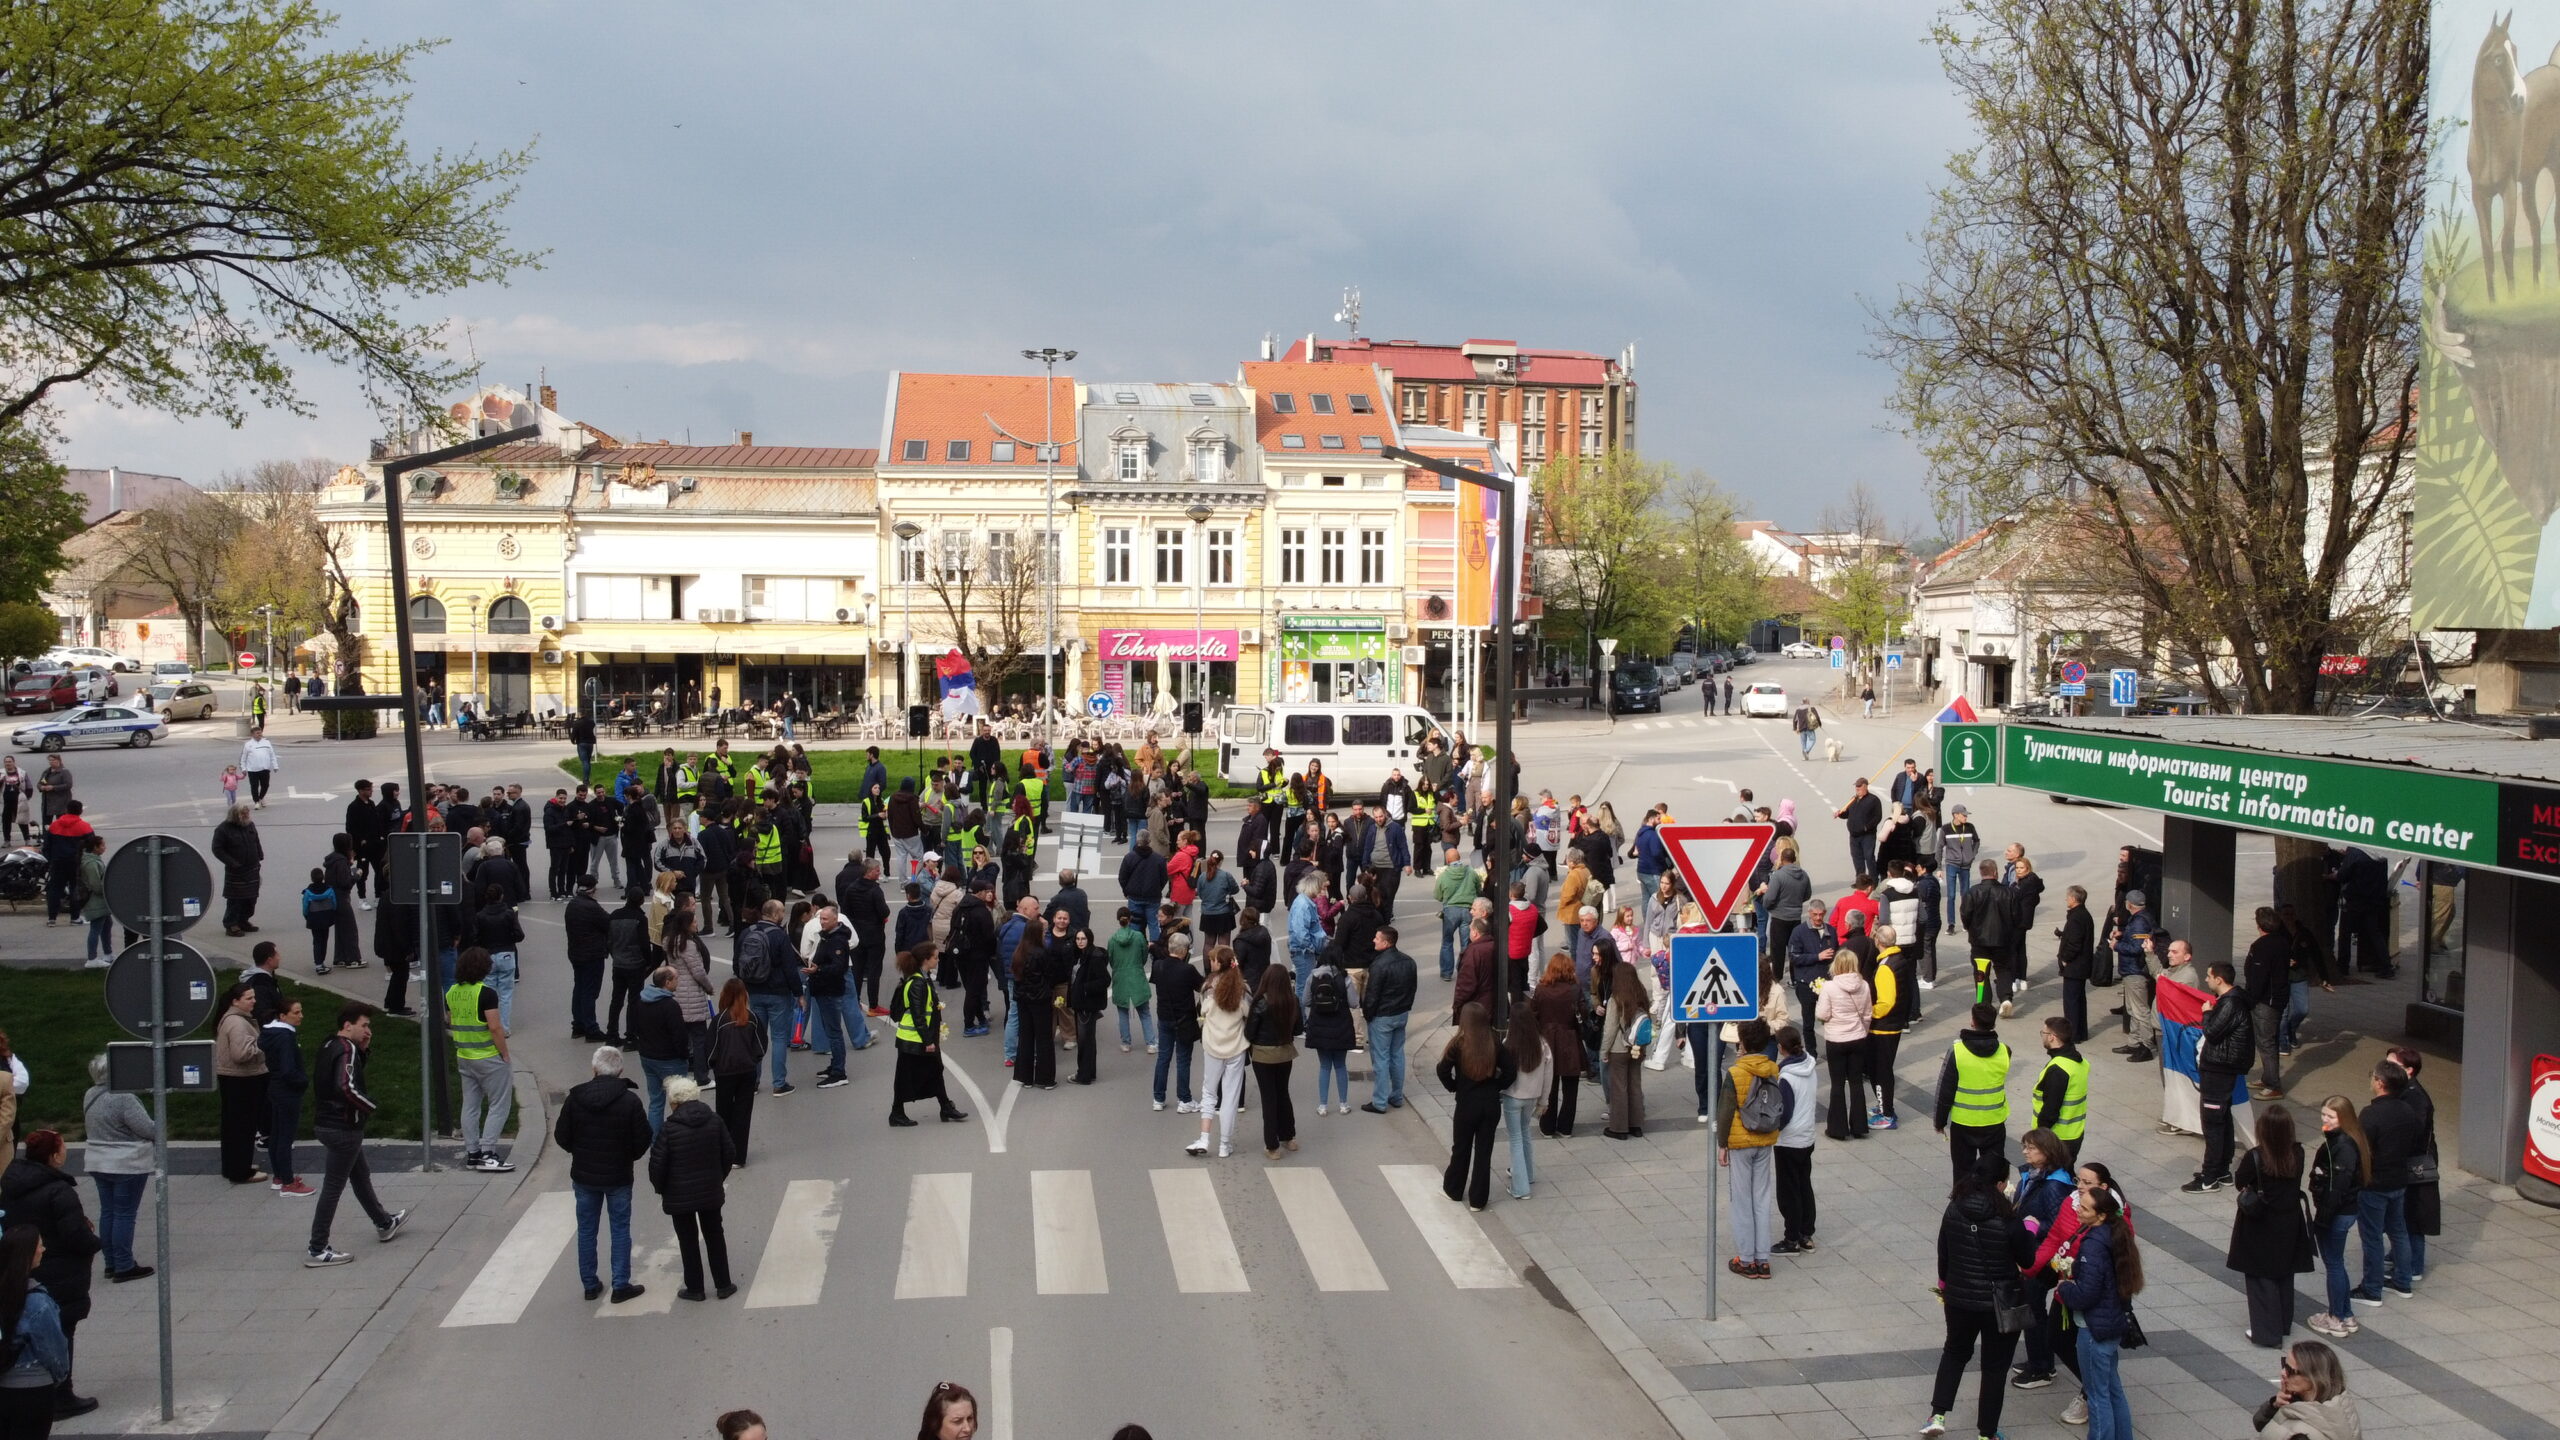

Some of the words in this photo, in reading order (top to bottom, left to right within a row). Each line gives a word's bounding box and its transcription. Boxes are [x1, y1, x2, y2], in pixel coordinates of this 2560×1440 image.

[1300, 619, 1337, 627] АПОТЕКА
[1432, 630, 1472, 640] PEKR
[82, 726, 124, 735] ПОЛИЦИЈА
[2023, 735, 2103, 765] Туристички
[2107, 749, 2232, 783] информативни
[2238, 767, 2308, 799] центар
[2163, 780, 2231, 812] Tourist
[2238, 791, 2375, 836] information
[2386, 819, 2474, 850] center
[2518, 837, 2560, 864] Exc
